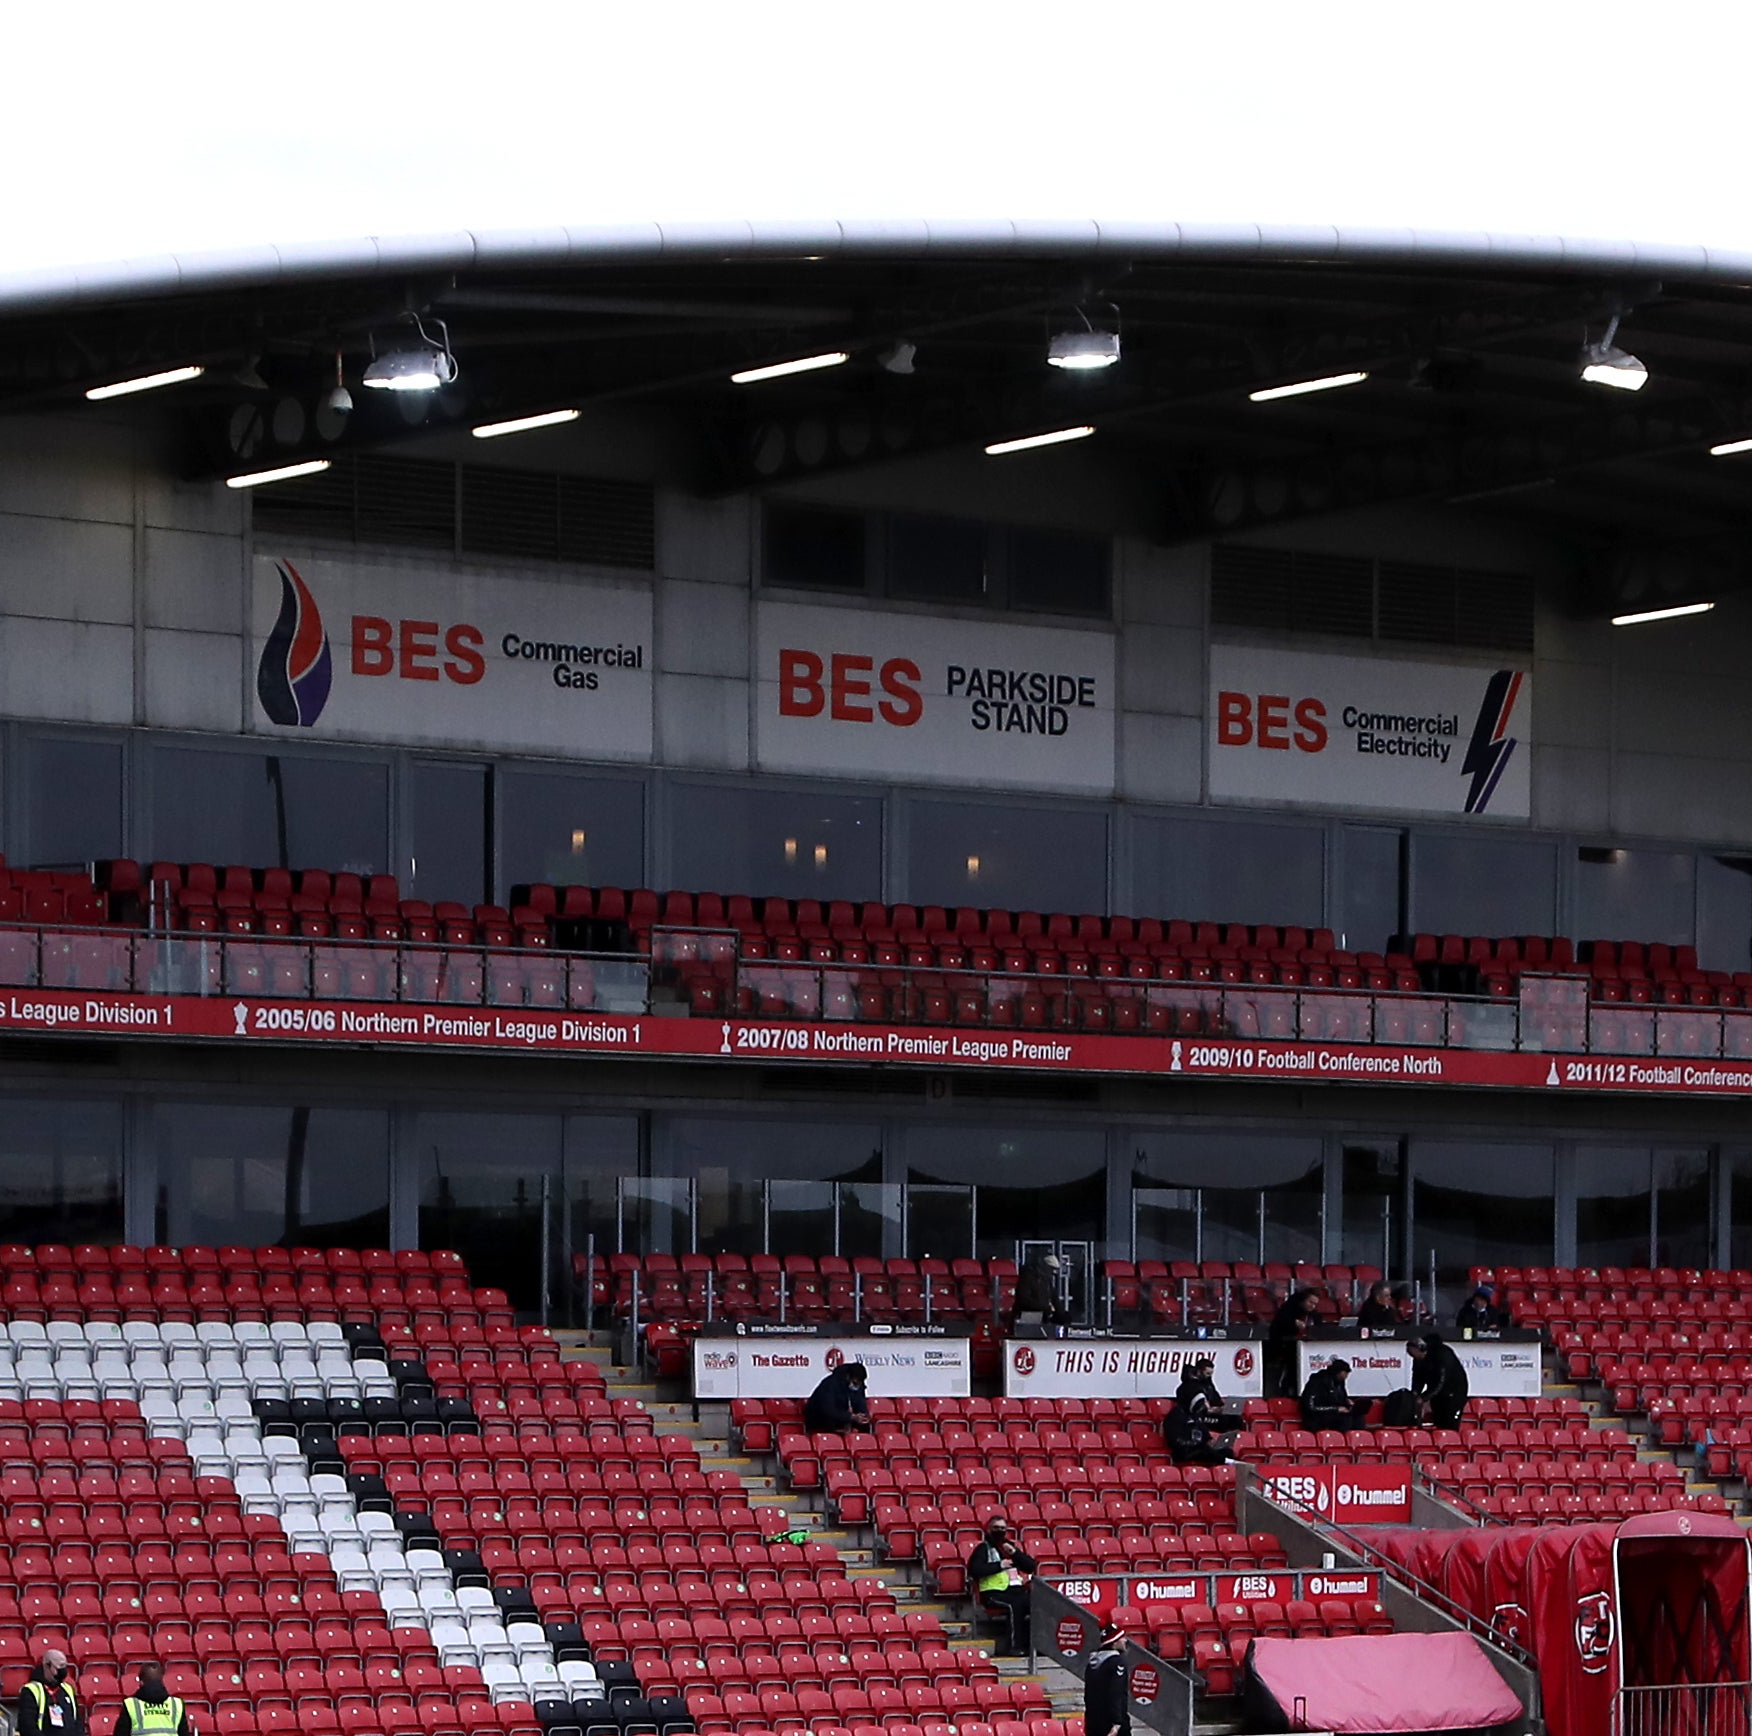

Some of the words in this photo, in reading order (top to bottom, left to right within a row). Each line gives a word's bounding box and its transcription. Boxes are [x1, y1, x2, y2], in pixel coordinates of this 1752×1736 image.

[350, 615, 486, 686] BES
[501, 633, 644, 671] Commercial
[552, 663, 600, 691] Gas
[778, 648, 924, 729] BES
[945, 663, 1097, 710] PARKSIDE
[970, 698, 1071, 738] STAND
[1216, 691, 1328, 753] BES
[1342, 705, 1460, 738] Commercial
[1355, 730, 1452, 766] Electricity
[11, 997, 80, 1026] League
[85, 1000, 158, 1025] Division
[162, 1004, 173, 1026] 1
[255, 1007, 335, 1032] 2005/06
[341, 1010, 418, 1036] Northern
[424, 1013, 491, 1038] Premier
[495, 1016, 556, 1043] League
[561, 1019, 627, 1043] Division
[632, 1023, 641, 1044] 1
[737, 1026, 809, 1051] 2007/08
[813, 1029, 884, 1054] Northern
[887, 1032, 948, 1056] Premier
[952, 1035, 1008, 1060] League
[1012, 1038, 1072, 1061] Premier
[1189, 1046, 1253, 1069] 2009/10
[1258, 1048, 1315, 1071] Football
[1319, 1050, 1399, 1073] Conference
[1403, 1053, 1442, 1075] North
[1566, 1062, 1626, 1083] 2011/12
[1629, 1064, 1681, 1085] Football
[932, 1077, 946, 1099] D
[752, 1354, 770, 1366] The
[772, 1354, 810, 1367] Gazette
[1056, 1351, 1094, 1373] THIS
[1101, 1351, 1121, 1373] IS
[1351, 1357, 1367, 1368] The
[1369, 1357, 1401, 1368] Gazette
[1277, 1477, 1316, 1500] BES
[1353, 1484, 1406, 1505] hummel
[1065, 1581, 1092, 1596] BES
[1149, 1580, 1196, 1599] hummel
[1242, 1577, 1268, 1592] BES
[1323, 1576, 1368, 1594] hummel
